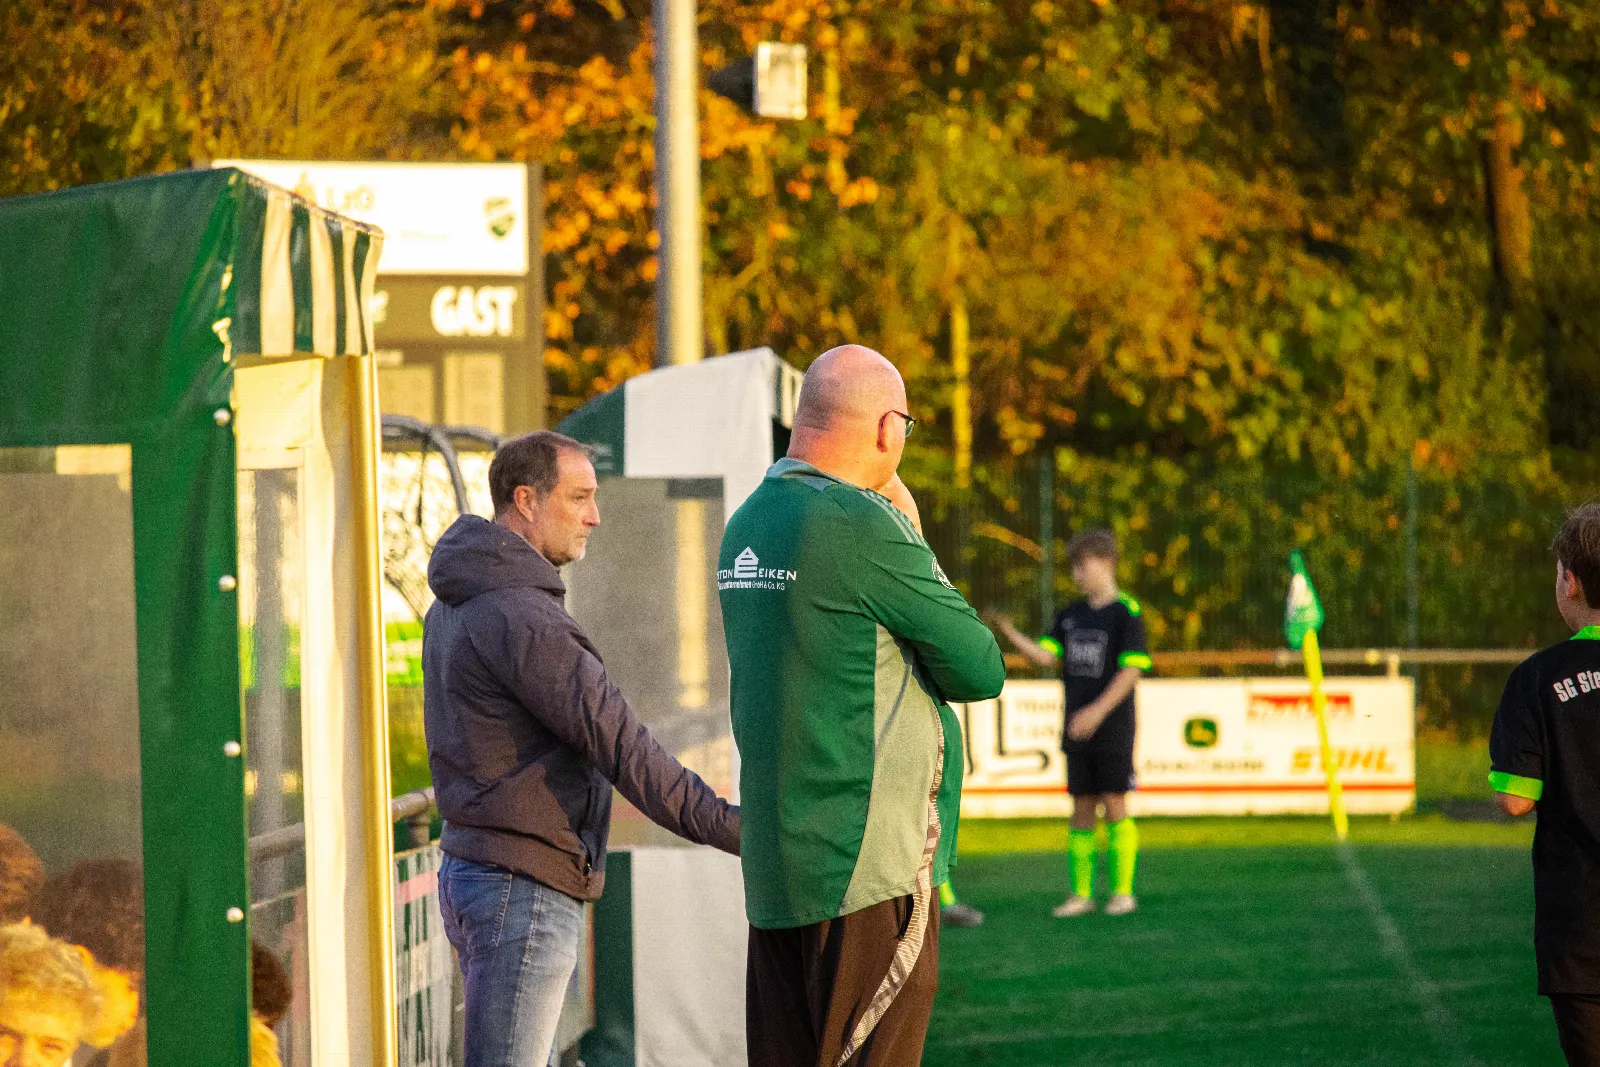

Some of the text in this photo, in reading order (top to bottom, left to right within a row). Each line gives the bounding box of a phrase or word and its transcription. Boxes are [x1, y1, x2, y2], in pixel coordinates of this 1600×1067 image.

[431, 286, 518, 336] GAST
[758, 568, 797, 581] EIKEN
[776, 582, 786, 591] KG
[1553, 677, 1579, 702] SG
